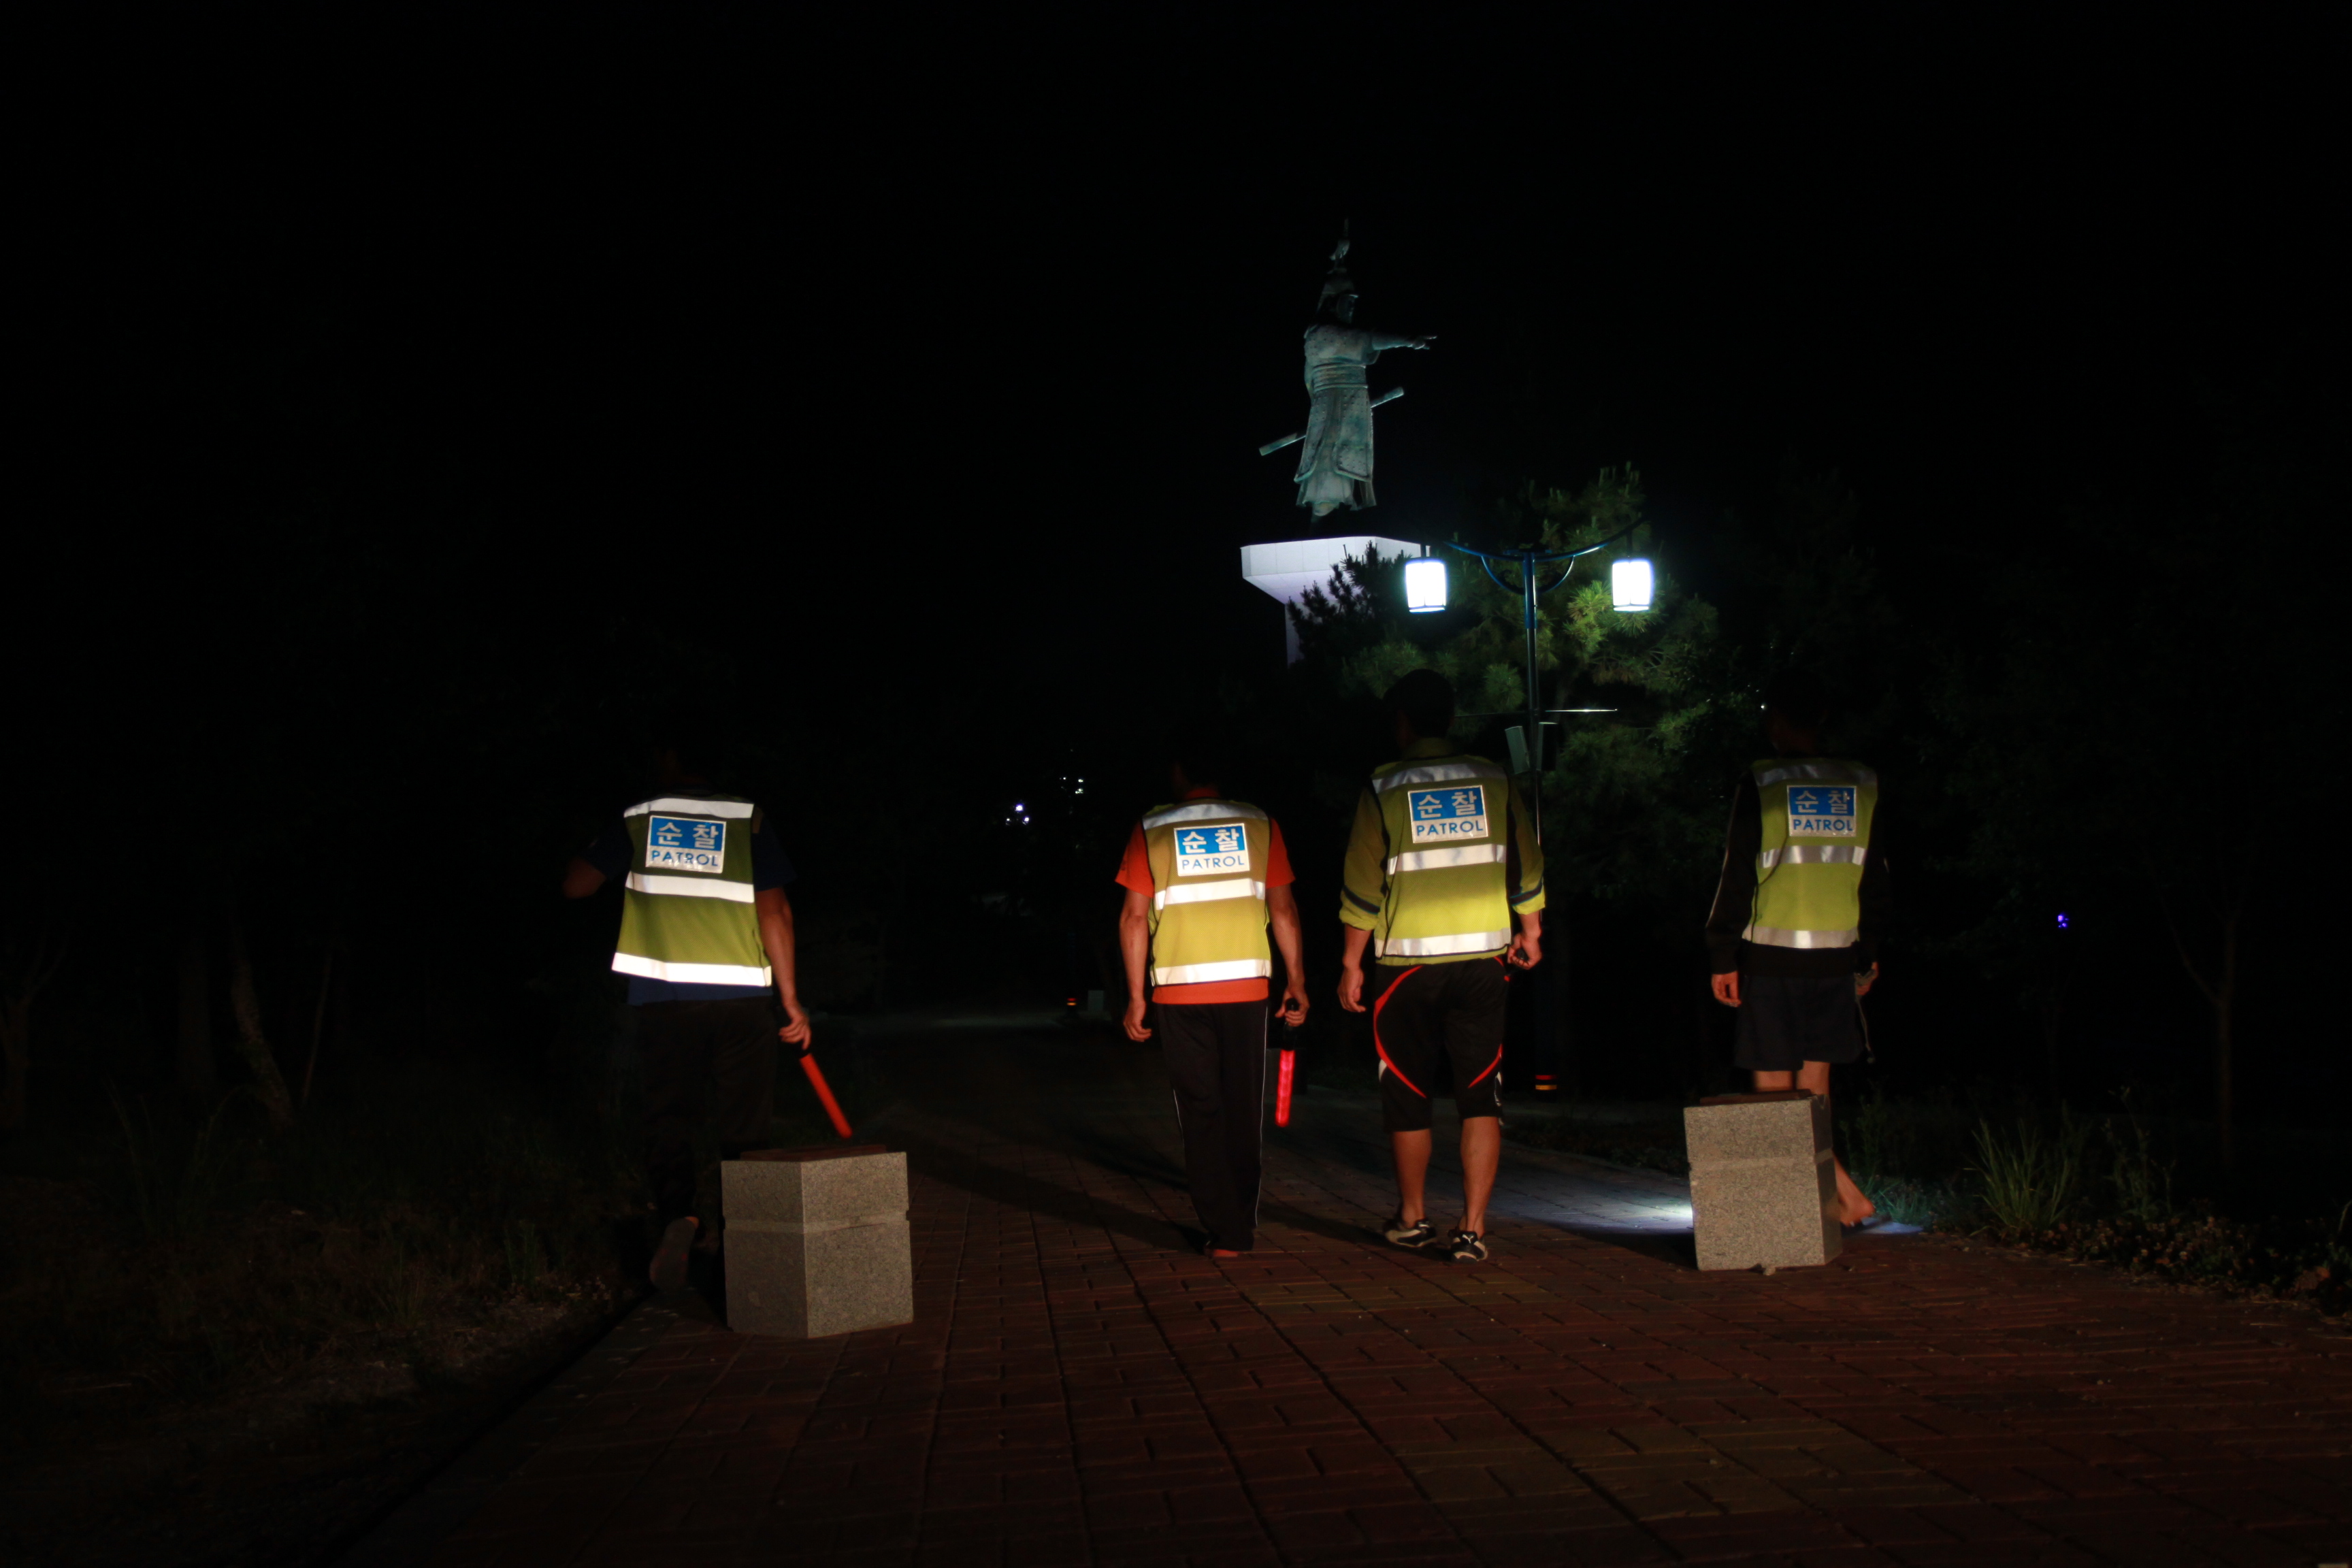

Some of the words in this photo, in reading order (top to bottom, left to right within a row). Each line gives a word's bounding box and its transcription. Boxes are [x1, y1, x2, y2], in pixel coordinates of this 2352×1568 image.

[1416, 820, 1484, 836] PATROL
[1793, 819, 1853, 831] PATROL
[651, 850, 719, 866] PATROL
[1182, 856, 1245, 870] PATROL
